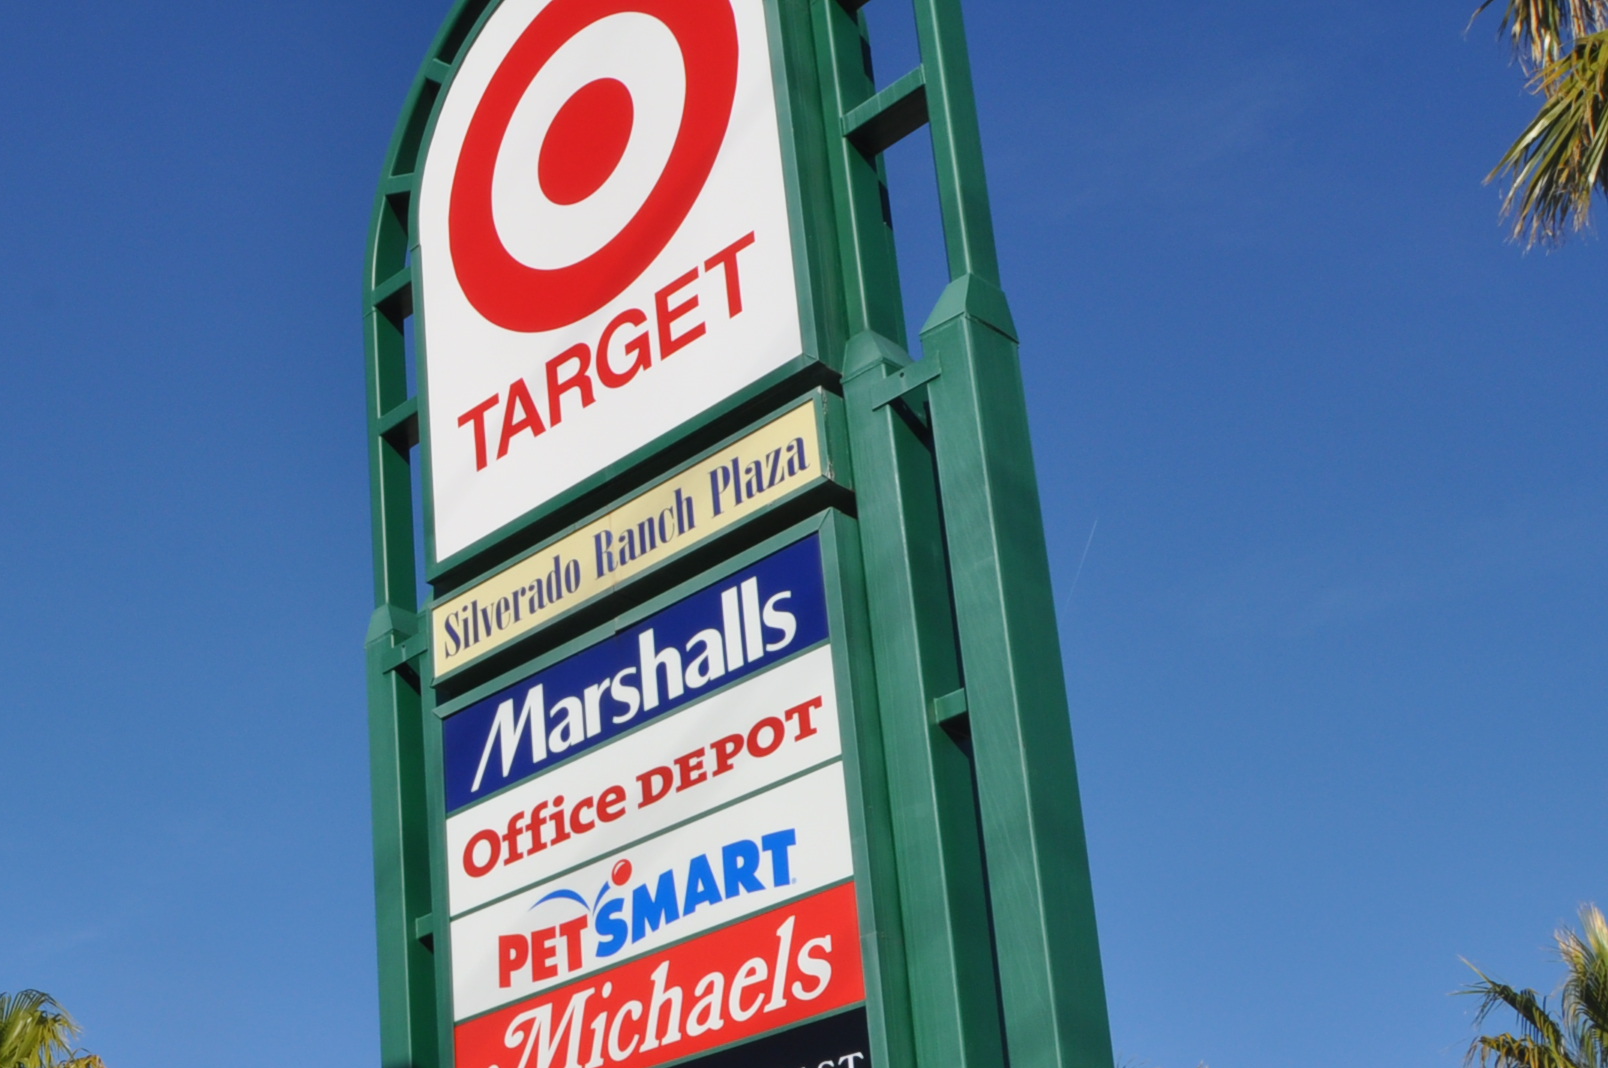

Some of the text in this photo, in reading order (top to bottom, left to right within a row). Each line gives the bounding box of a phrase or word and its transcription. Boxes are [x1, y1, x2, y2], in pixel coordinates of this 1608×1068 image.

[457, 230, 756, 471] TARGET
[444, 436, 810, 659] Silverado Ranch Plaza
[462, 694, 823, 878] Office DEPOT
[470, 575, 798, 793] Marshalls
